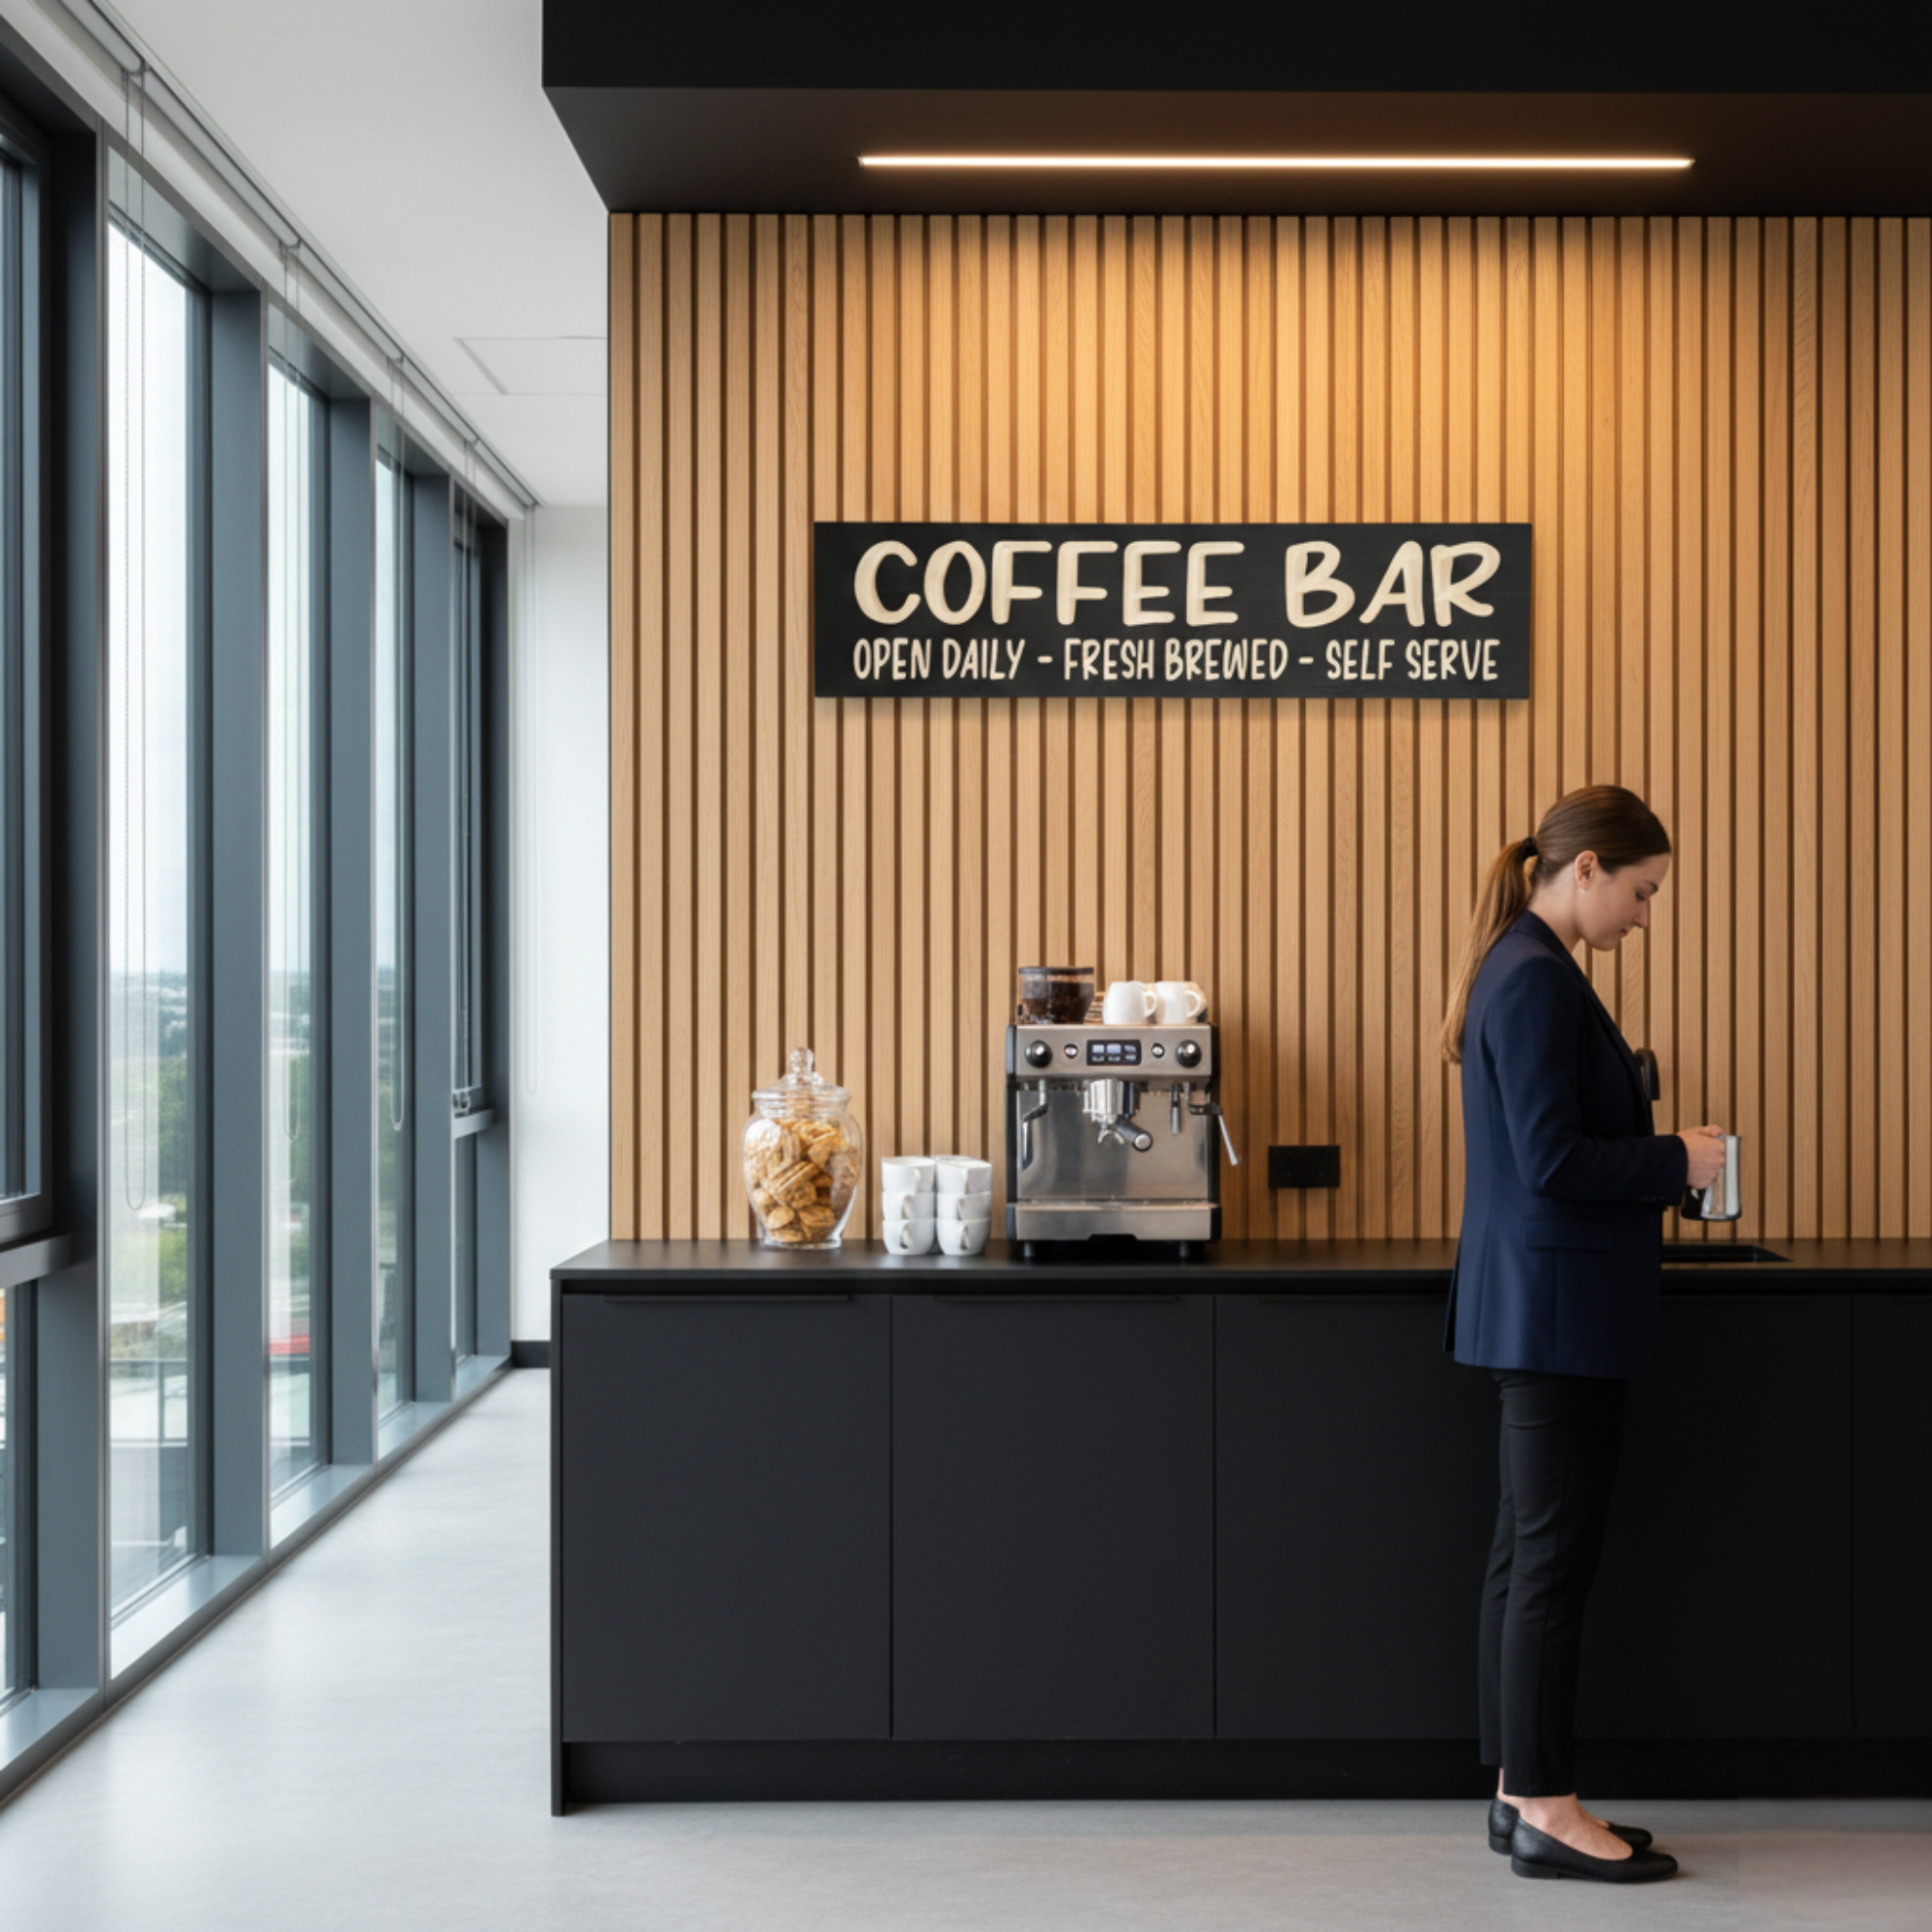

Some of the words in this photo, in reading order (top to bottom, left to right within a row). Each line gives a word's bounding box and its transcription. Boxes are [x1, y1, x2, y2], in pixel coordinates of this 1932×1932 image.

[854, 540, 1245, 627] COFFEE
[1285, 540, 1501, 629] BAR
[853, 638, 931, 680] OPEN
[942, 638, 1026, 680] DAILY
[1064, 638, 1155, 681] FRESH
[1164, 638, 1289, 681] BREWED
[1325, 638, 1396, 681] SELF
[1405, 638, 1500, 681] SERVE
